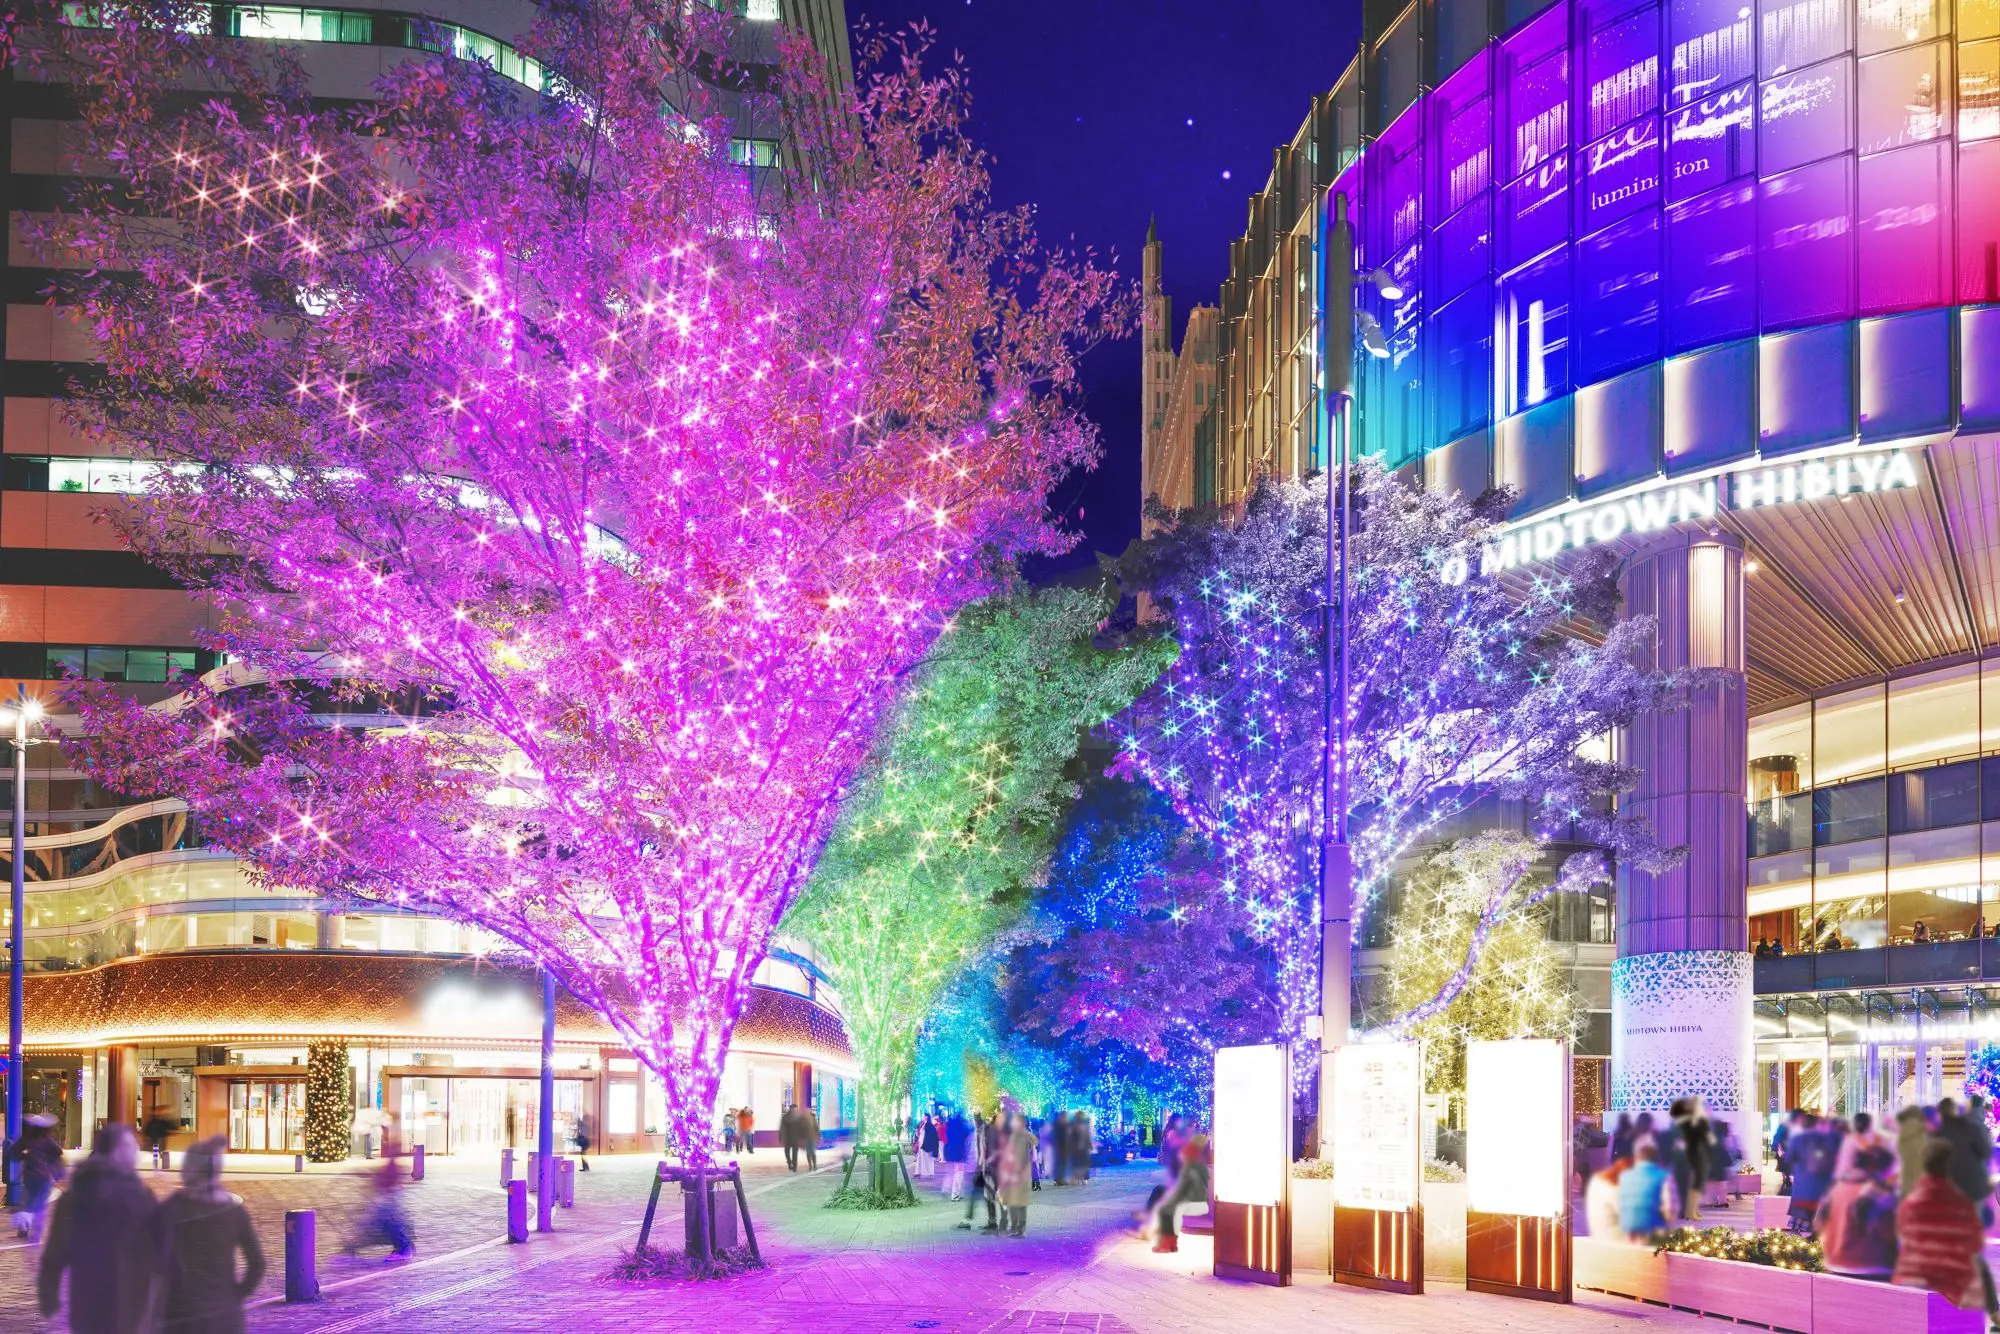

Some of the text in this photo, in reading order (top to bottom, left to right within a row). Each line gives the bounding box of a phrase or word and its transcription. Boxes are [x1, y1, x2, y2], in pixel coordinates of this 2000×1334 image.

[1481, 481, 1715, 576] MIDTOWN
[1739, 452, 1918, 509] HIBIYA
[1626, 1025, 1703, 1036] MIDTOWN HIBIYA
